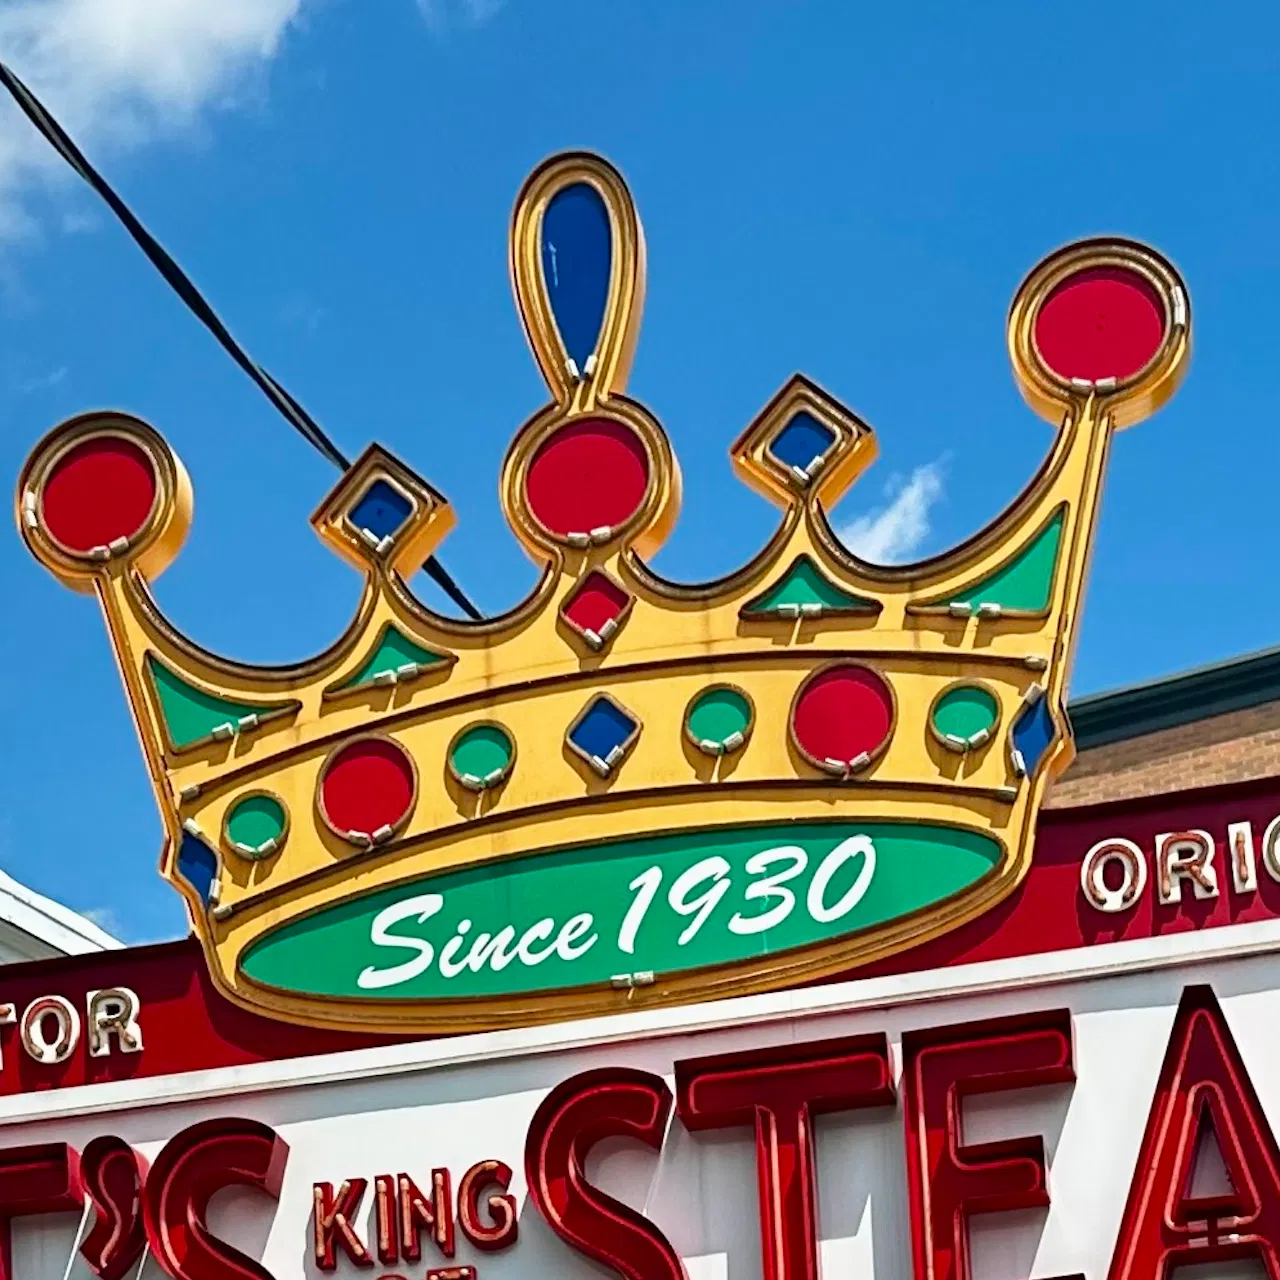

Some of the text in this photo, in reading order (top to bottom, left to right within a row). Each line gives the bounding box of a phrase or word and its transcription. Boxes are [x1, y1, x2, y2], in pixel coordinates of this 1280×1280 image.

[357, 833, 876, 991] Since 1930
[314, 1160, 518, 1272] KING
